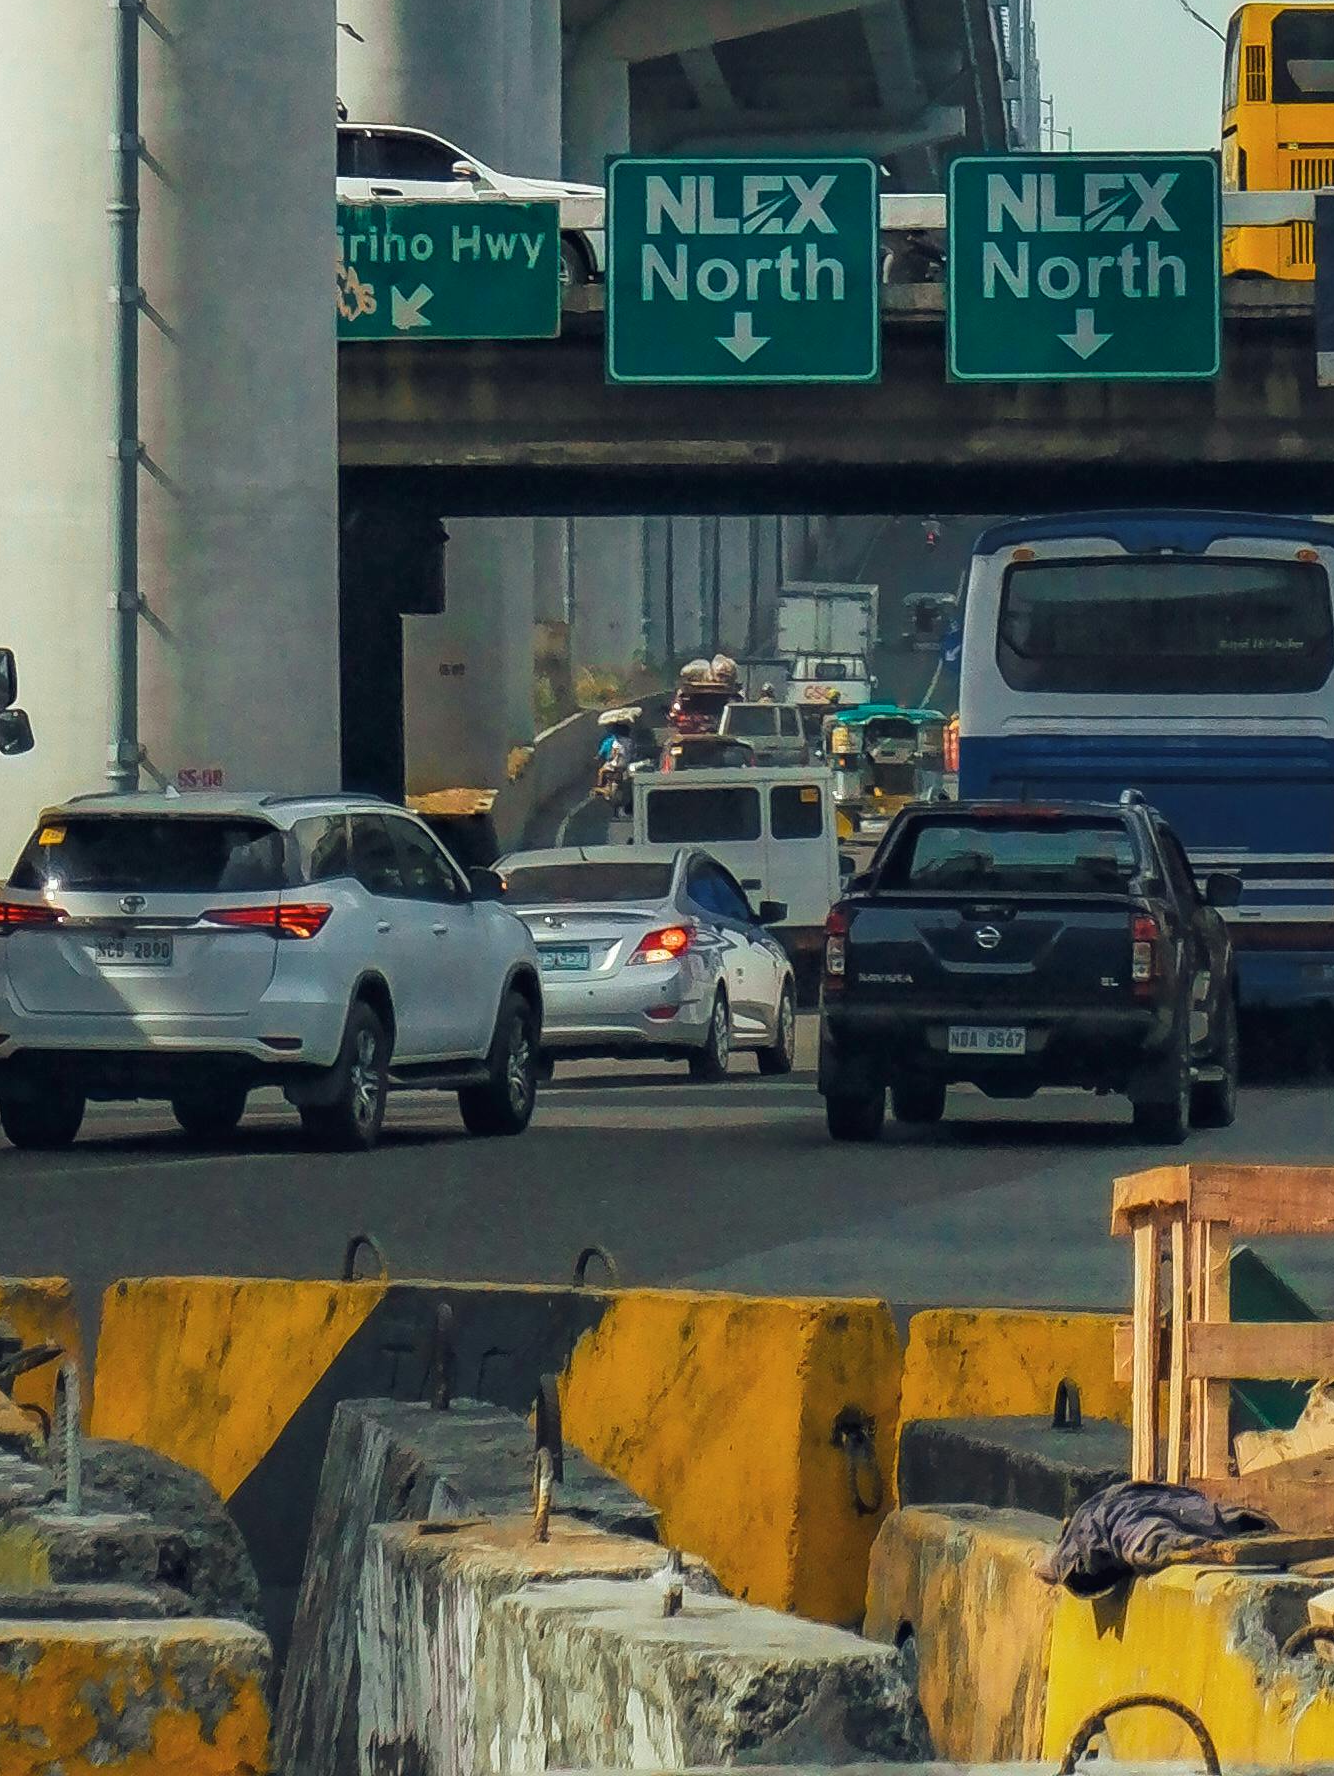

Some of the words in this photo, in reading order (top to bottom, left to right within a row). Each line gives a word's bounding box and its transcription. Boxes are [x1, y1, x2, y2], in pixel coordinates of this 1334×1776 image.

[645, 174, 840, 236] NLEX
[985, 172, 1182, 233] NLEX
[335, 224, 435, 265] irino
[451, 224, 546, 270] Hwy
[641, 242, 846, 303] North
[982, 240, 1188, 299] North
